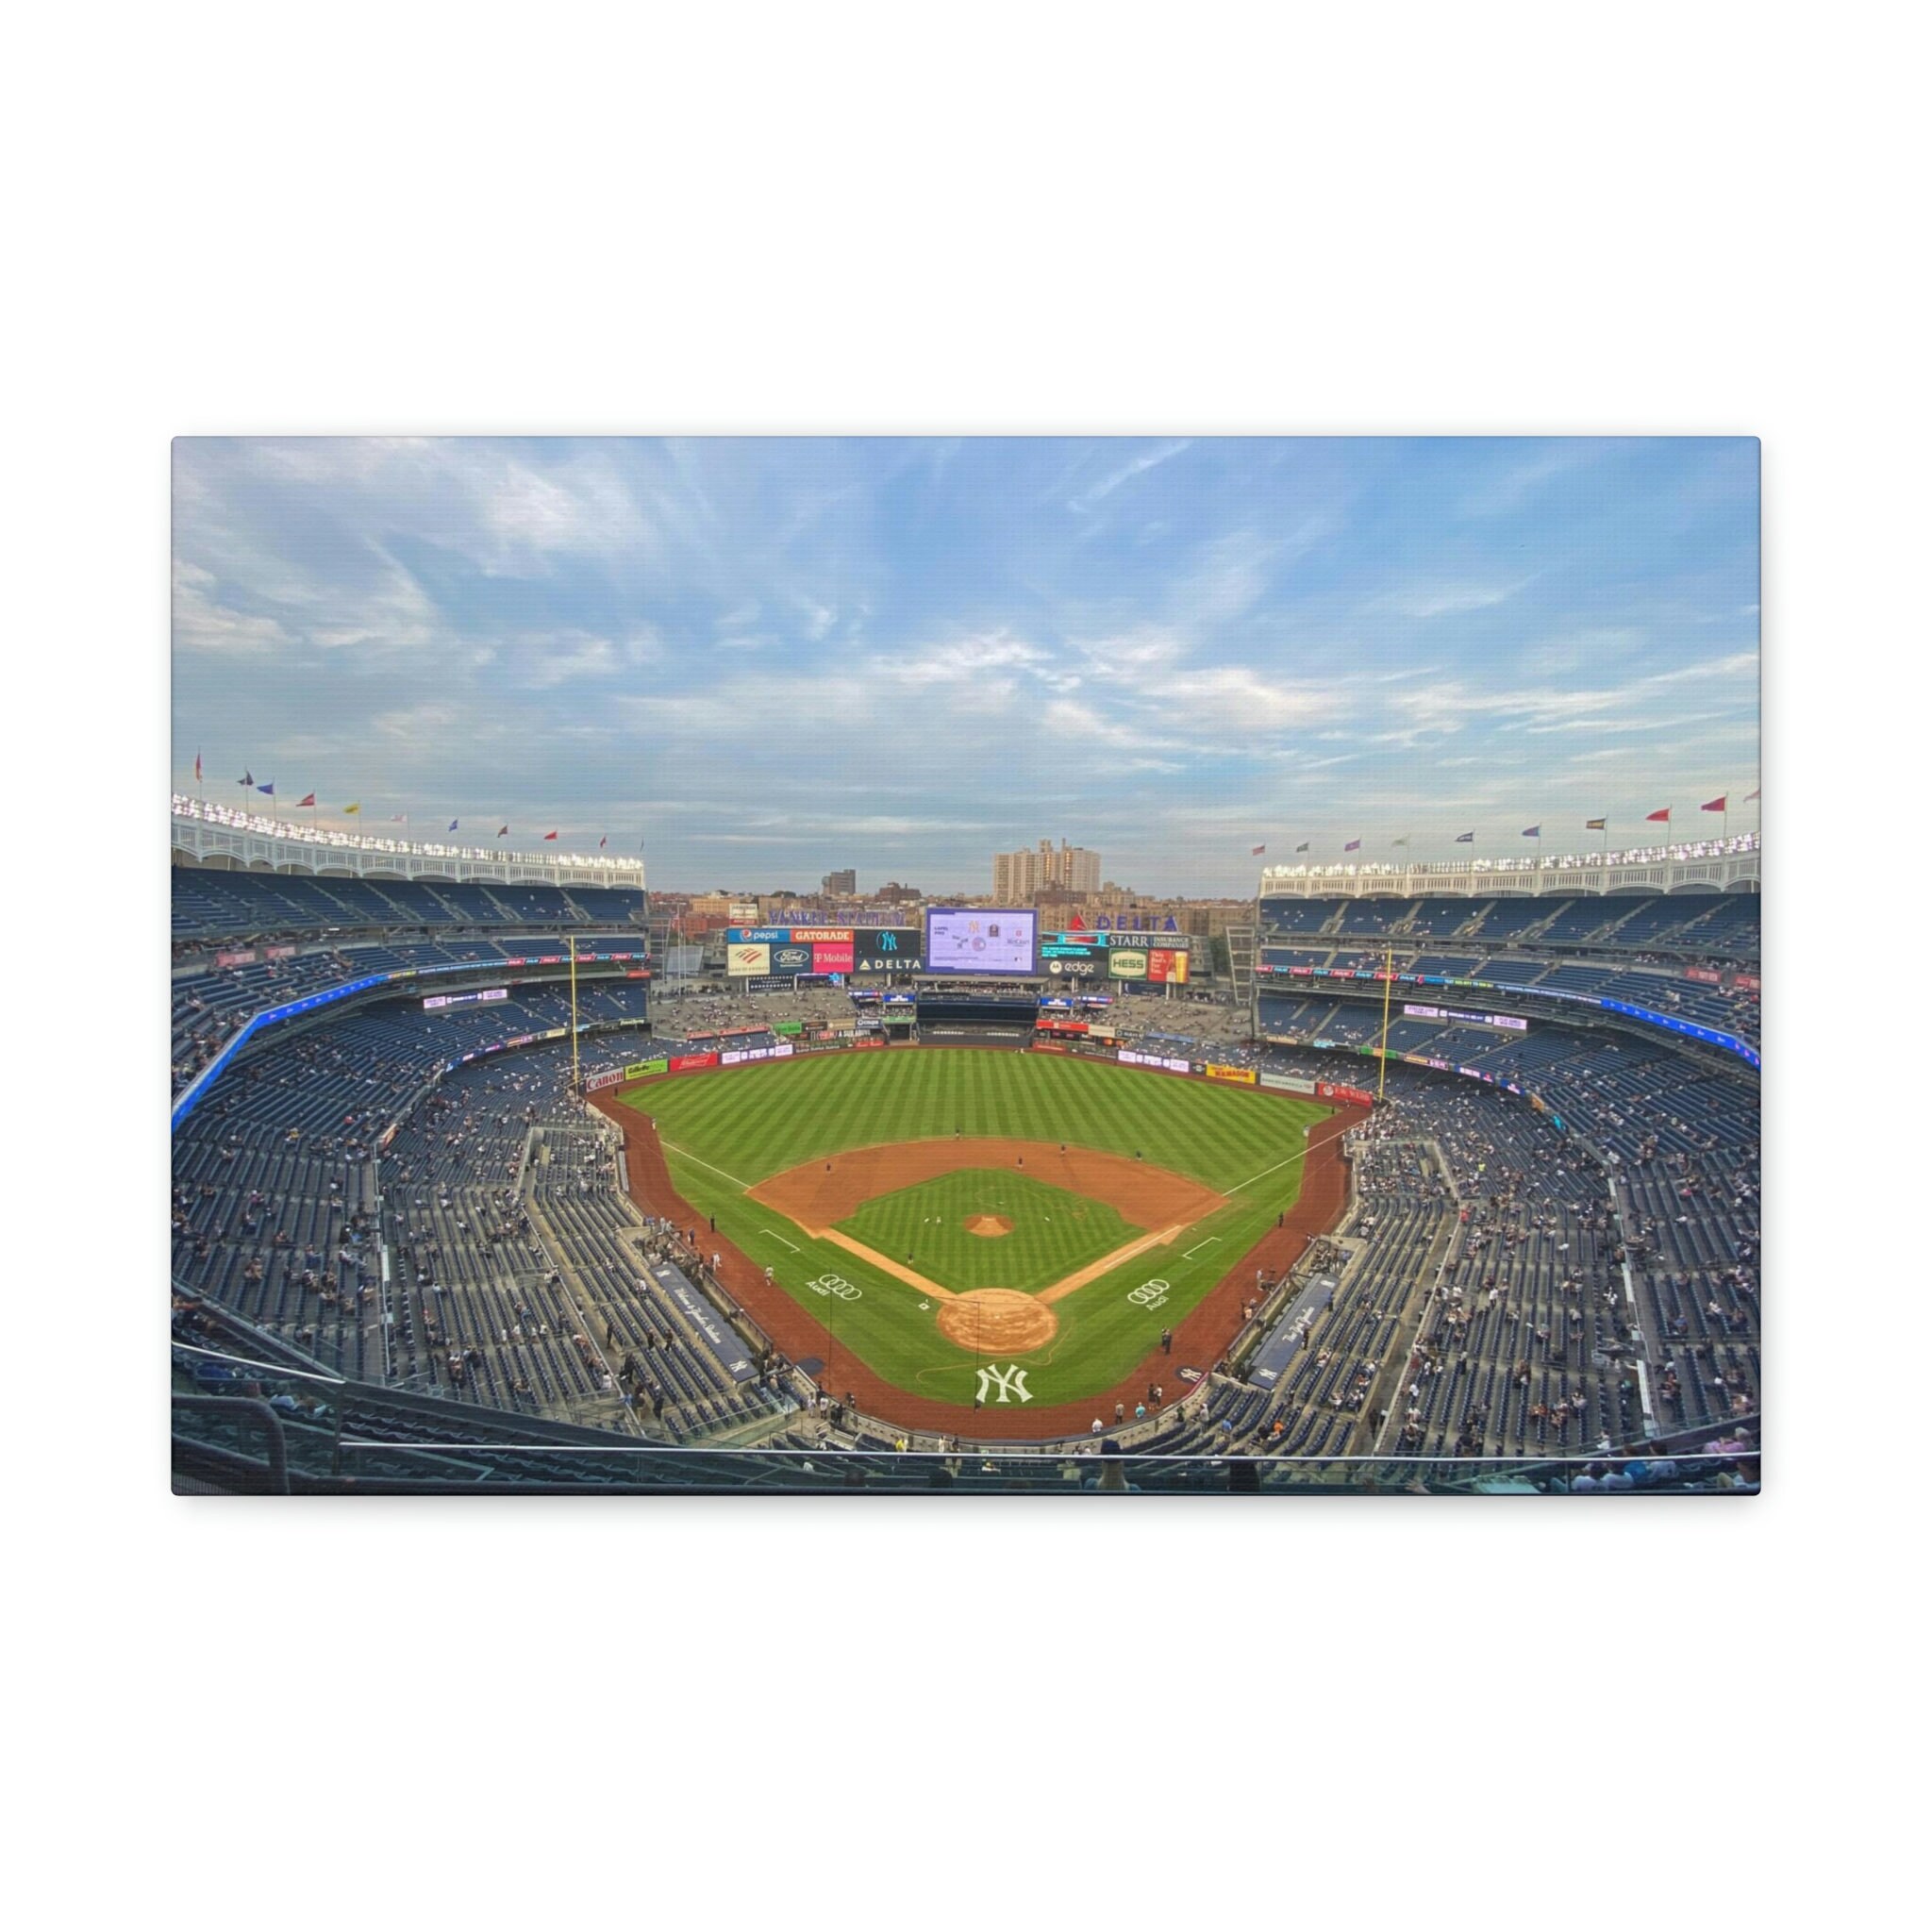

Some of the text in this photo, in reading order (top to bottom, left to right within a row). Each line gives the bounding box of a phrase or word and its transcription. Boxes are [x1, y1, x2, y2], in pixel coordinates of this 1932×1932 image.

[1096, 915, 1177, 931] DELTA
[754, 931, 778, 941] pepsi
[795, 932, 850, 941] GATORADE
[1110, 935, 1149, 947] STARR
[780, 951, 802, 962] Ford
[824, 953, 854, 962] Mobile
[874, 959, 921, 970] DELTA
[1064, 961, 1094, 975] edge
[1113, 958, 1144, 969] HESS
[587, 1072, 624, 1090] Canon
[805, 1280, 830, 1297] Audi
[1145, 1295, 1168, 1311] Audi
[975, 1364, 1033, 1403] NY
